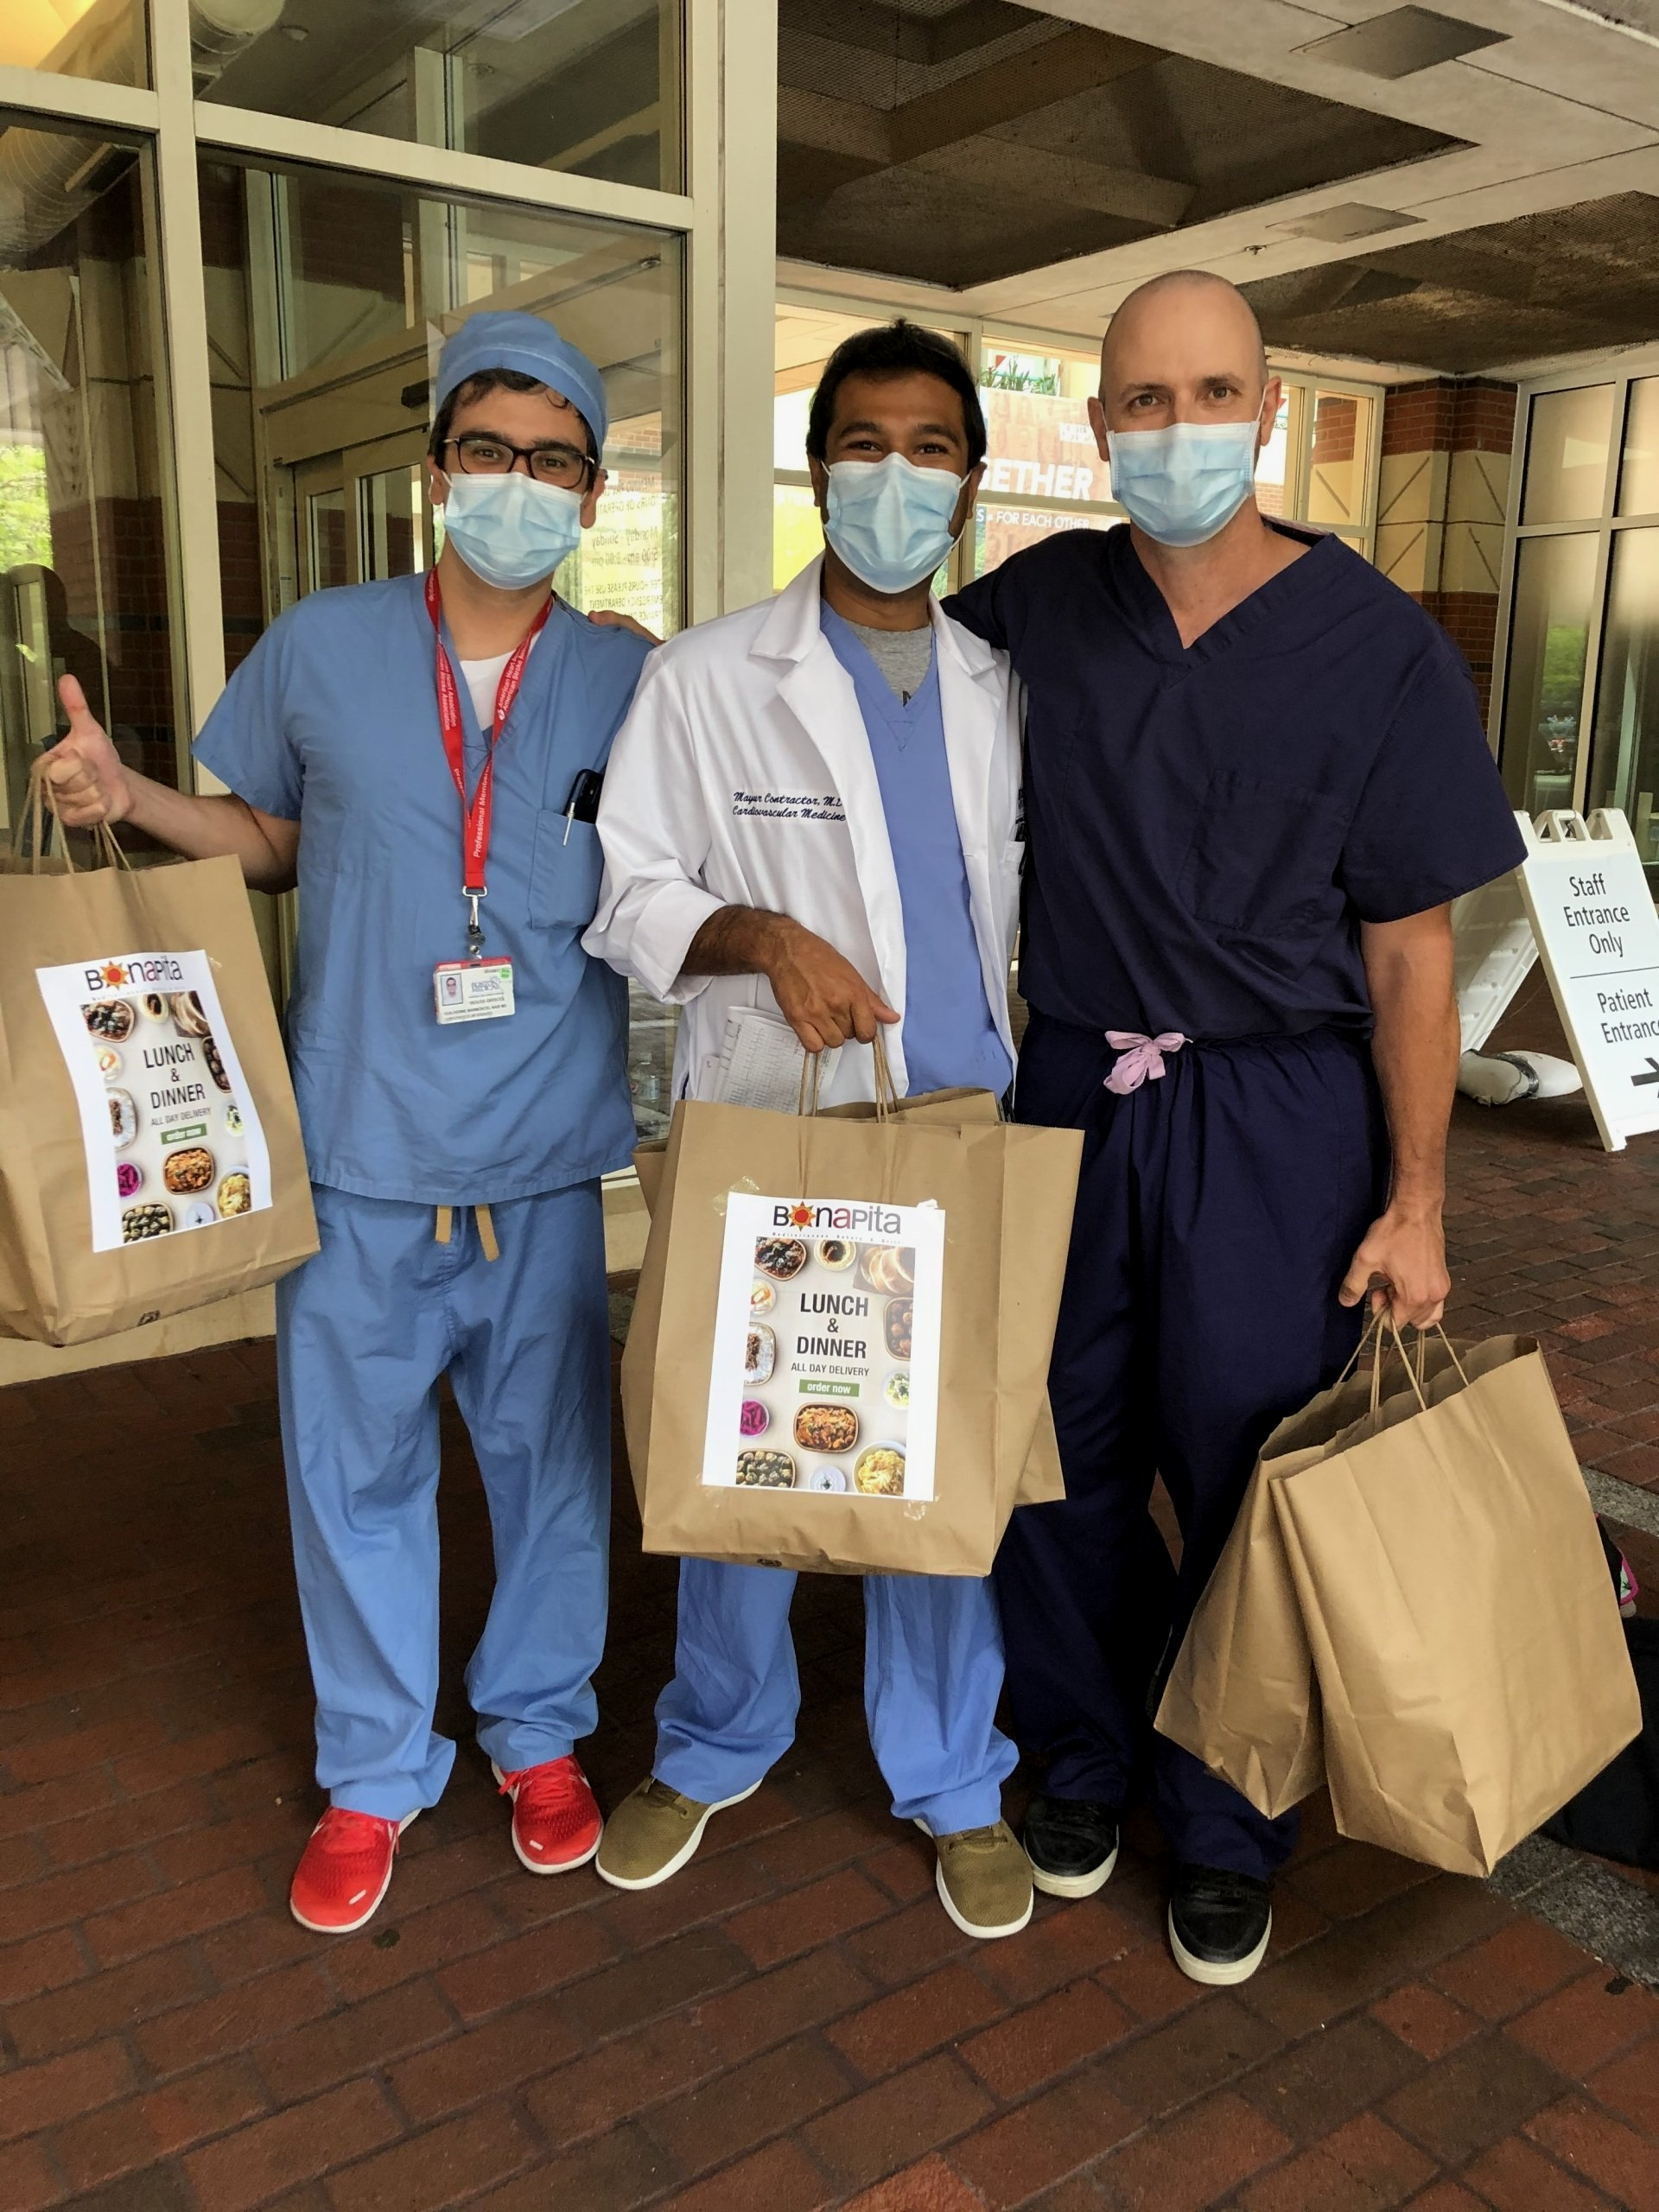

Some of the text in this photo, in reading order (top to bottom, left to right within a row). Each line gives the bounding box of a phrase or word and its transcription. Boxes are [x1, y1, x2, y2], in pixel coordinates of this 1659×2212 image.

[996, 511, 1020, 525] FOR
[1022, 513, 1052, 528] EACH
[1054, 516, 1090, 530] OTHER
[498, 662, 516, 709] American Heart
[502, 680, 518, 711] American
[512, 660, 523, 681] Stroke
[733, 791, 762, 804] Mayur
[765, 792, 820, 806] Contractor,
[733, 805, 846, 822] Cardiovascular Medicine
[473, 807, 486, 858] Professional
[1569, 873, 1606, 897] Staff
[1563, 903, 1630, 928] Entrance
[1588, 931, 1624, 957] Only
[1597, 988, 1653, 1014] Patient
[1600, 1018, 1659, 1044] Entranc
[143, 1043, 195, 1068] LUNCH
[170, 1068, 180, 1082] &
[150, 1084, 206, 1109] DINNER
[165, 1114, 180, 1123] DAY
[181, 1107, 212, 1121] DELIVERY
[800, 1293, 868, 1317] LUNCH
[827, 1318, 839, 1333] &
[797, 1336, 867, 1359] DINNER
[791, 1363, 869, 1376] ALL DAY DELIVERY
[807, 1382, 851, 1394] order now
